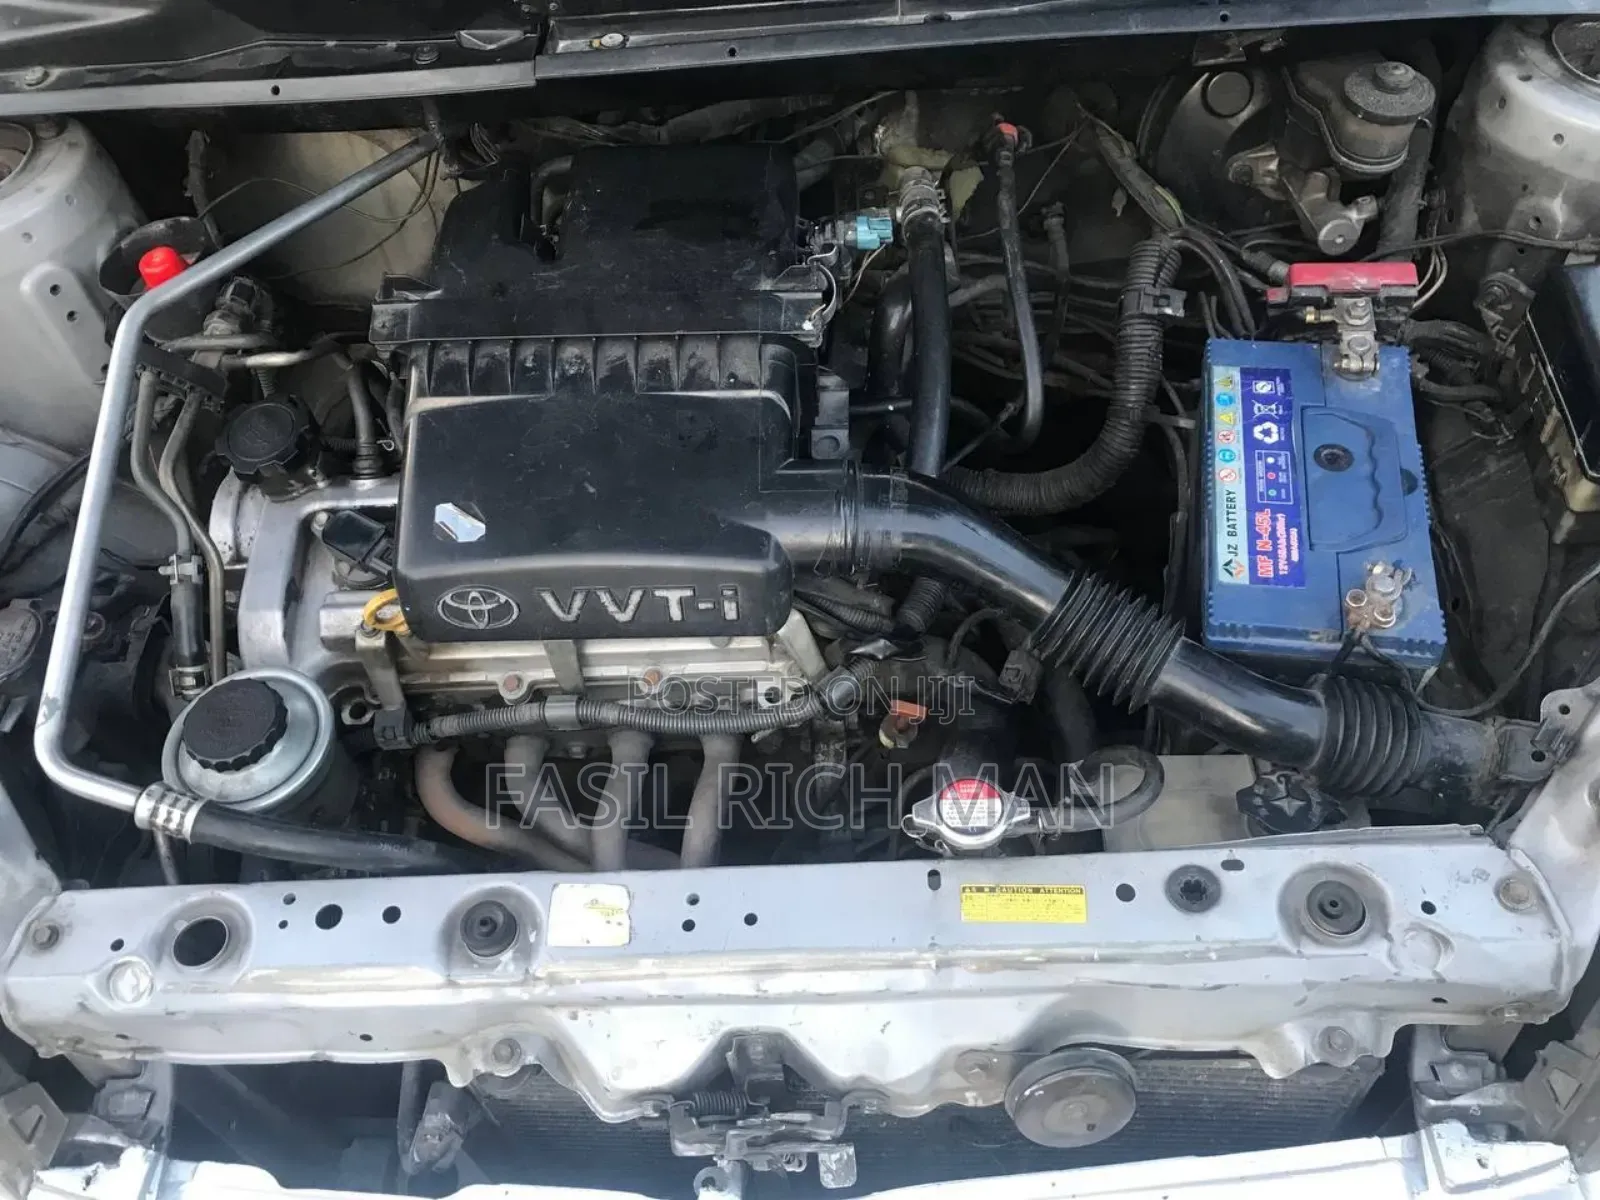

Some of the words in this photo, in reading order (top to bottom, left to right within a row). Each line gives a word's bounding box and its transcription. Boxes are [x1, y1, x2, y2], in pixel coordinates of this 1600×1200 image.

[1225, 489, 1238, 537] BATTERY
[1227, 543, 1238, 557] JZ
[1257, 555, 1274, 578] MF
[536, 586, 740, 622] VVT-i
